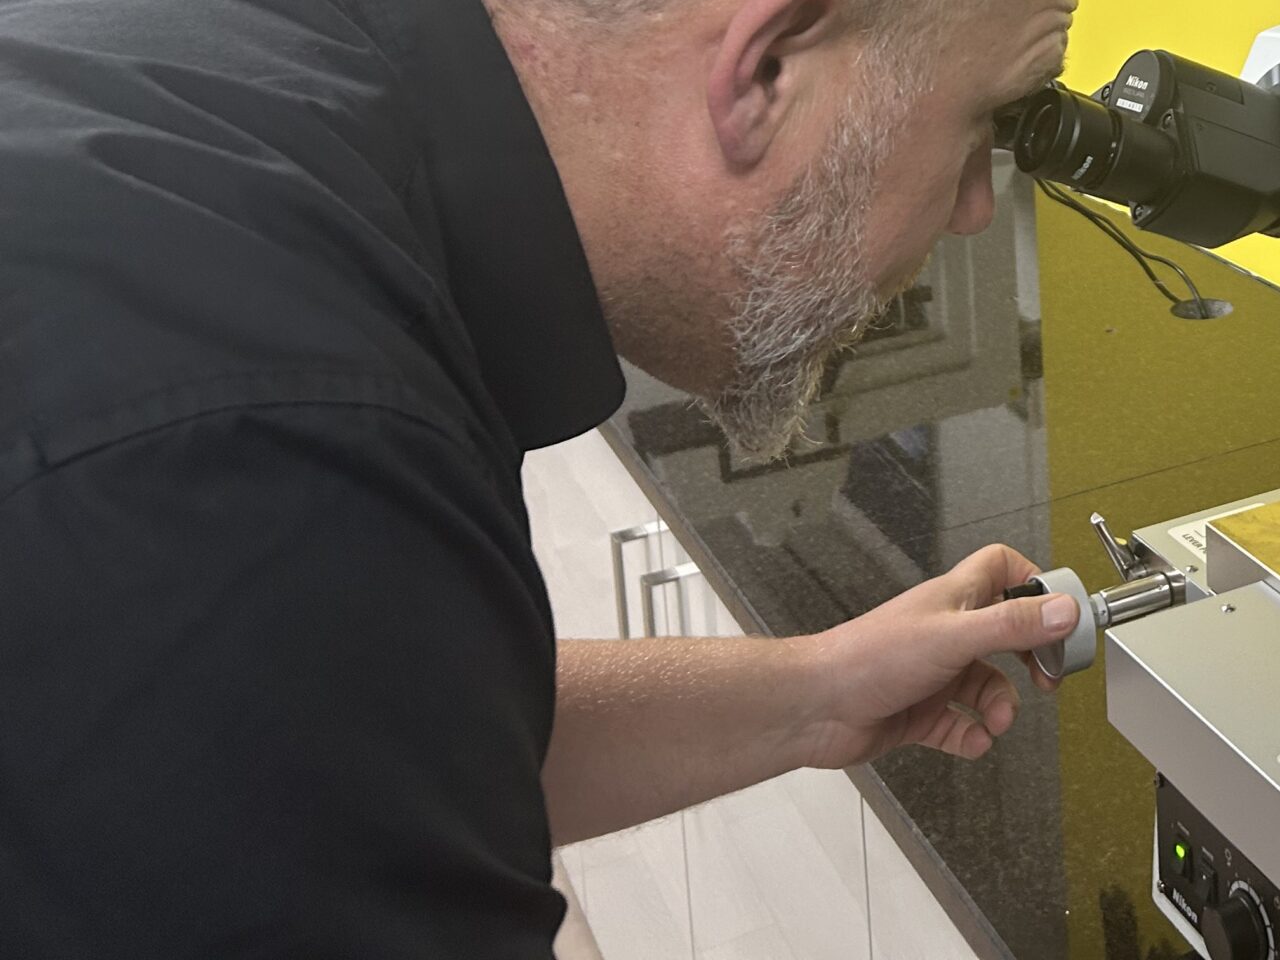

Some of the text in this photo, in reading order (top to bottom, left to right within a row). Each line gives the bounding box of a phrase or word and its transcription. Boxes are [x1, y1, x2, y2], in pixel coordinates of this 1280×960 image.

[1126, 74, 1149, 90] Nikon
[1072, 156, 1093, 180] Nikon
[1173, 888, 1198, 924] Nikon
